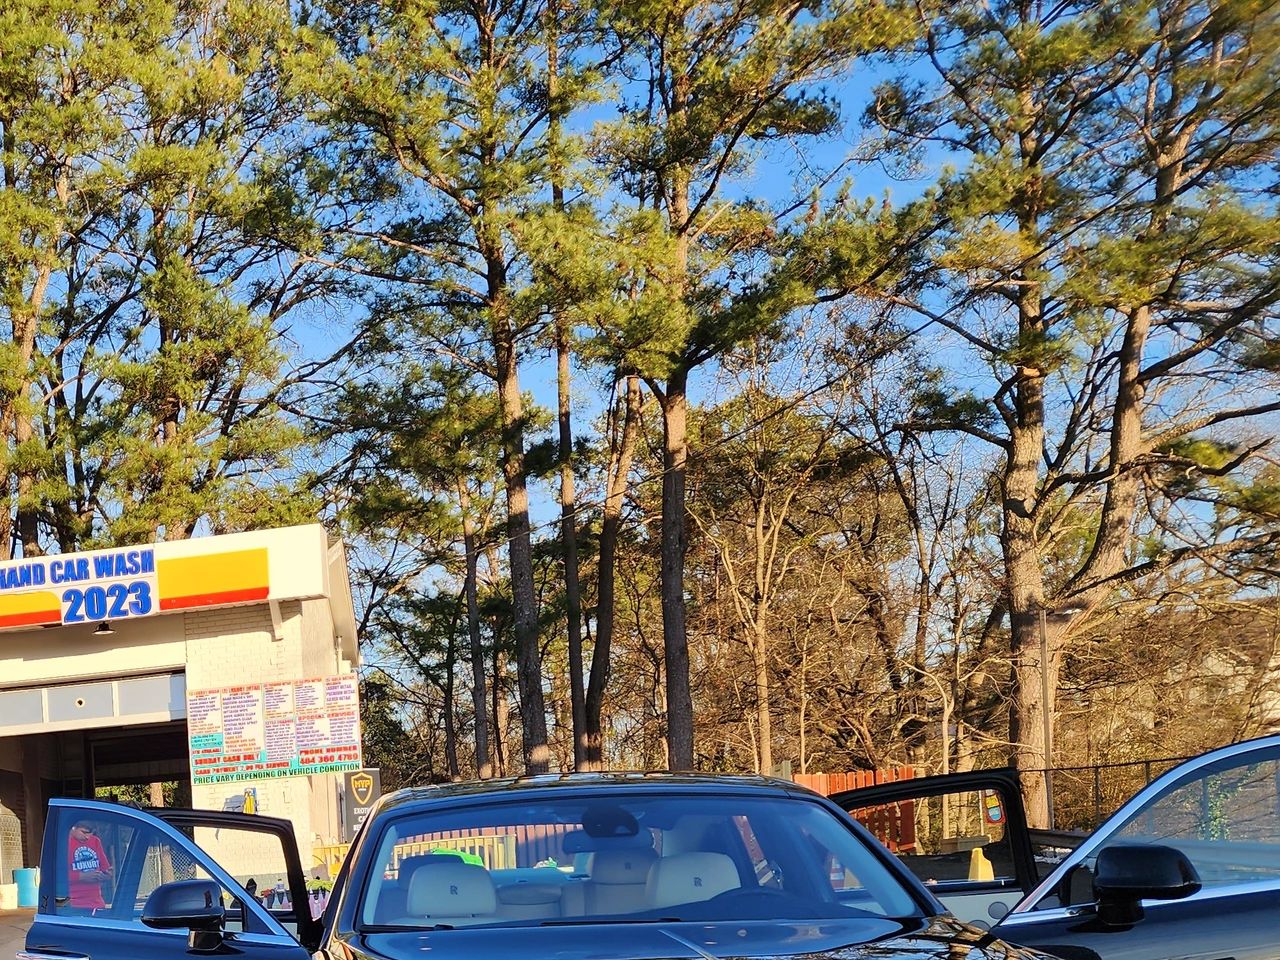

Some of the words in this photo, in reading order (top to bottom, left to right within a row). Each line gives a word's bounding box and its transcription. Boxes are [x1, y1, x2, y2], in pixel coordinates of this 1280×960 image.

[50, 556, 90, 584] CAR
[93, 549, 155, 578] WASH
[62, 581, 152, 624] 2023
[194, 776, 214, 784] PRICE
[216, 774, 235, 782] VARY
[236, 770, 275, 781] DEPENDING
[277, 769, 287, 777] ON
[288, 766, 318, 776] VEHICLE
[320, 762, 360, 773] CONDITION
